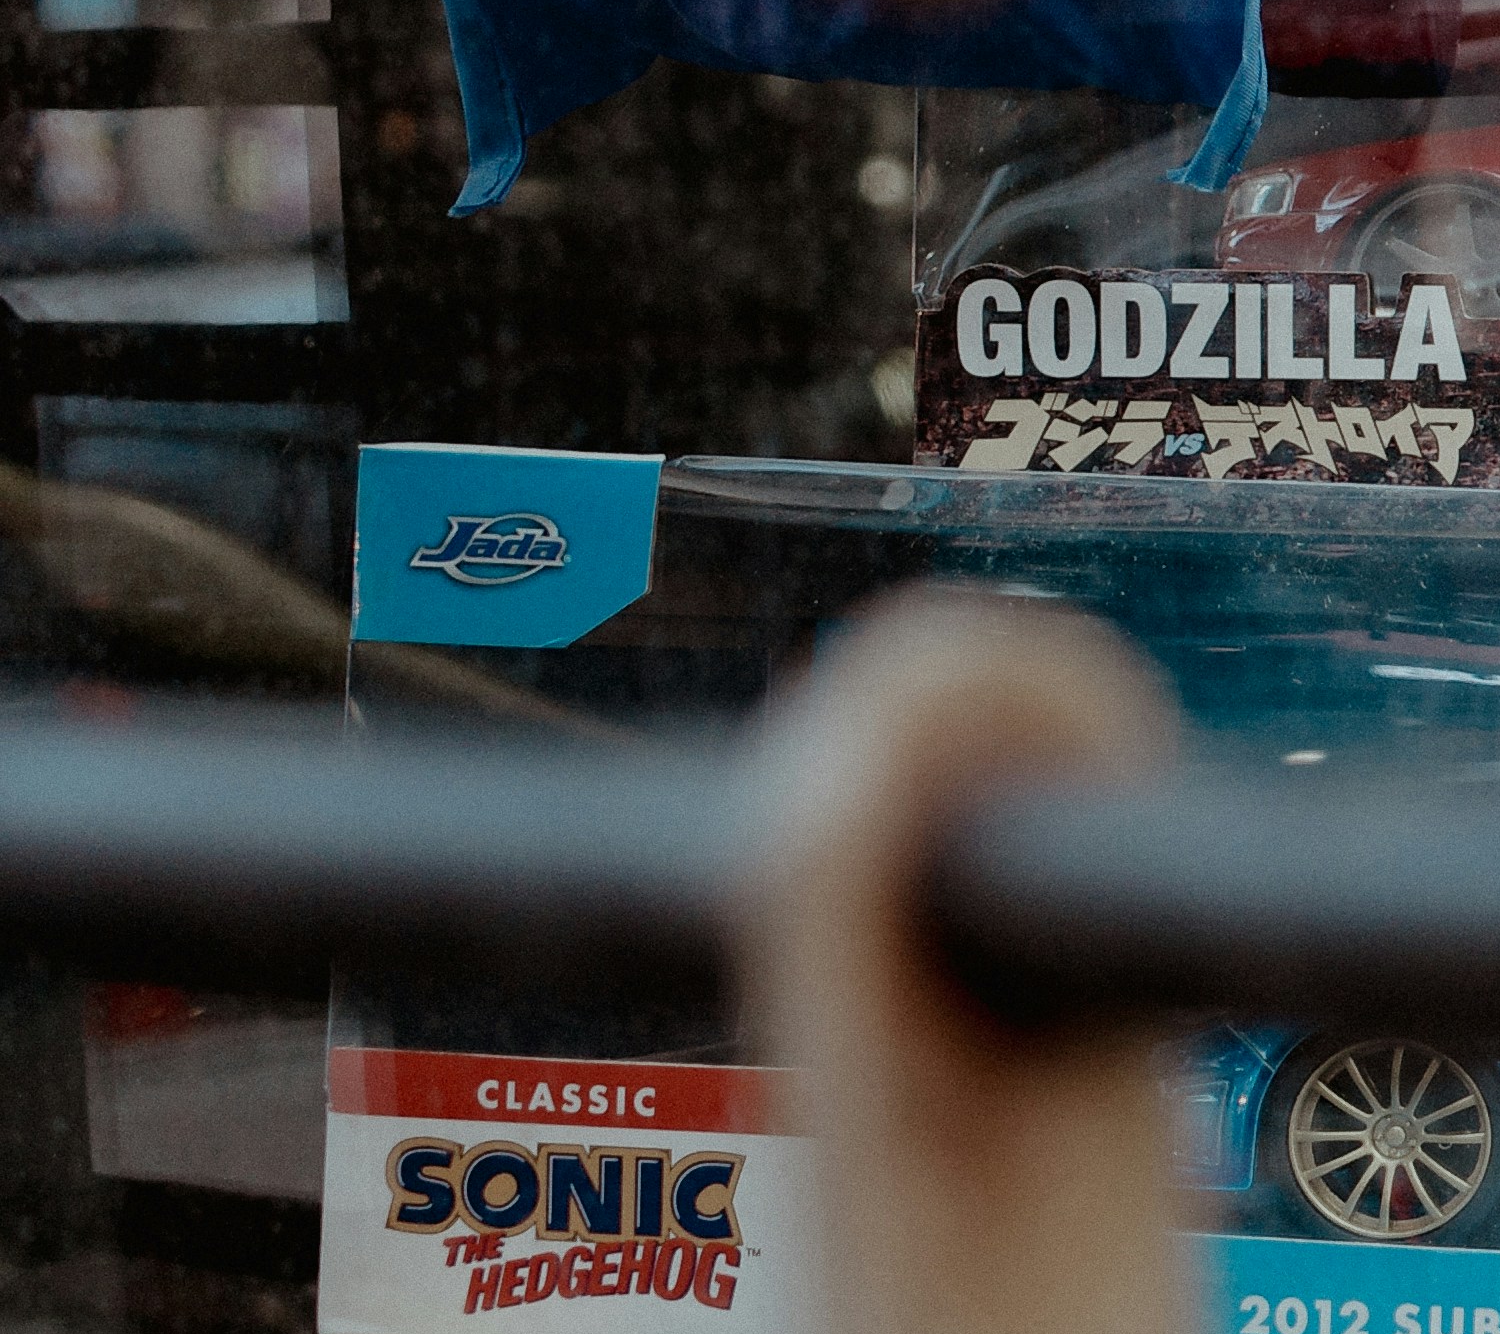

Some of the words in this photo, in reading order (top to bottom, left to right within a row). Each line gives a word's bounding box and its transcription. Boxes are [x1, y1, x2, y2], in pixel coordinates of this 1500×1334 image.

[955, 278, 1468, 383] GODZILLA
[409, 514, 565, 569] Jada
[477, 1079, 657, 1118] CLASSIC
[386, 1136, 746, 1244] SONIC
[443, 1234, 506, 1266] THE
[463, 1237, 741, 1314] HEDGEHOG
